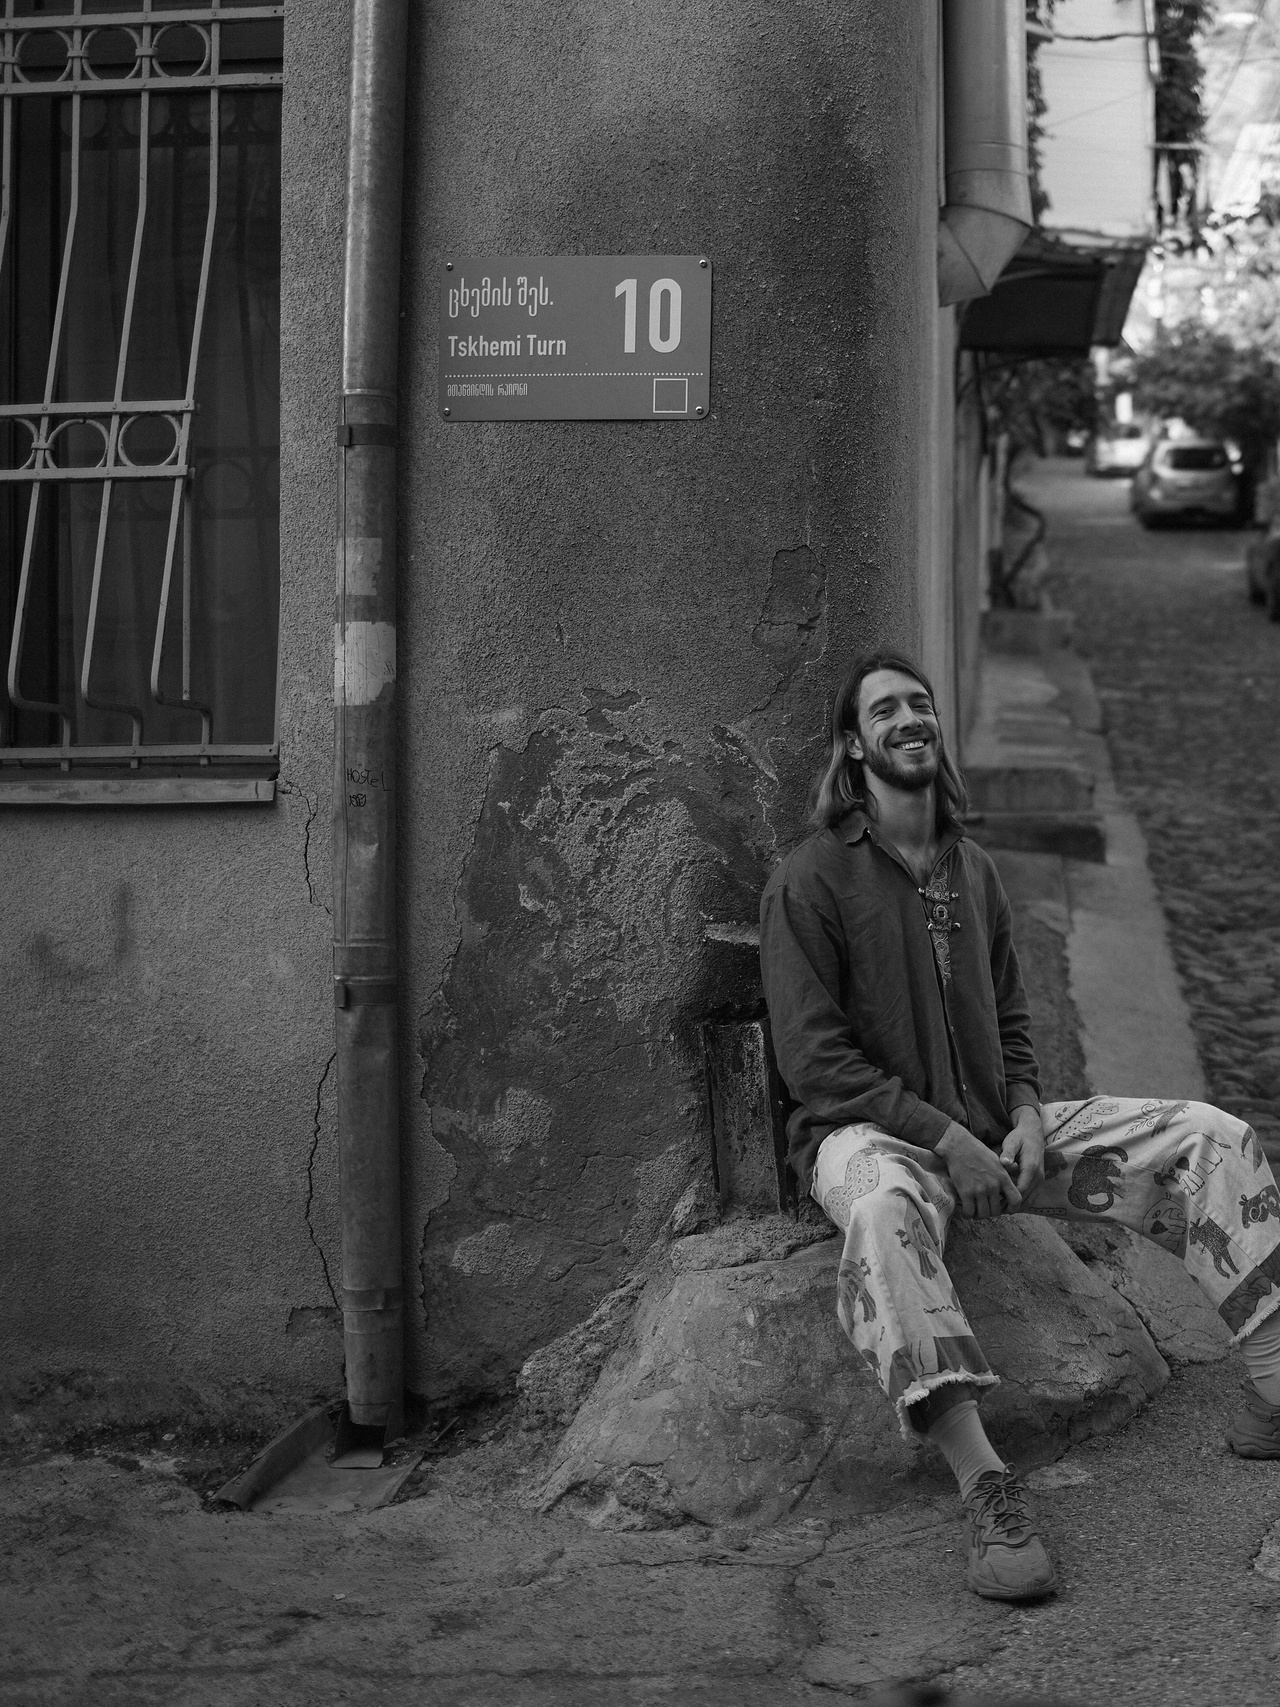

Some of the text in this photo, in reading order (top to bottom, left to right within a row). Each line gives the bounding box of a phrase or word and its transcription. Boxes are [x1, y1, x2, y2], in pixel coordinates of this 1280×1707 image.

[448, 276, 554, 318] ცხემის შეს.
[614, 278, 682, 353] 10
[448, 334, 567, 357] Tskhemi Turn
[497, 382, 528, 396] რაიონი
